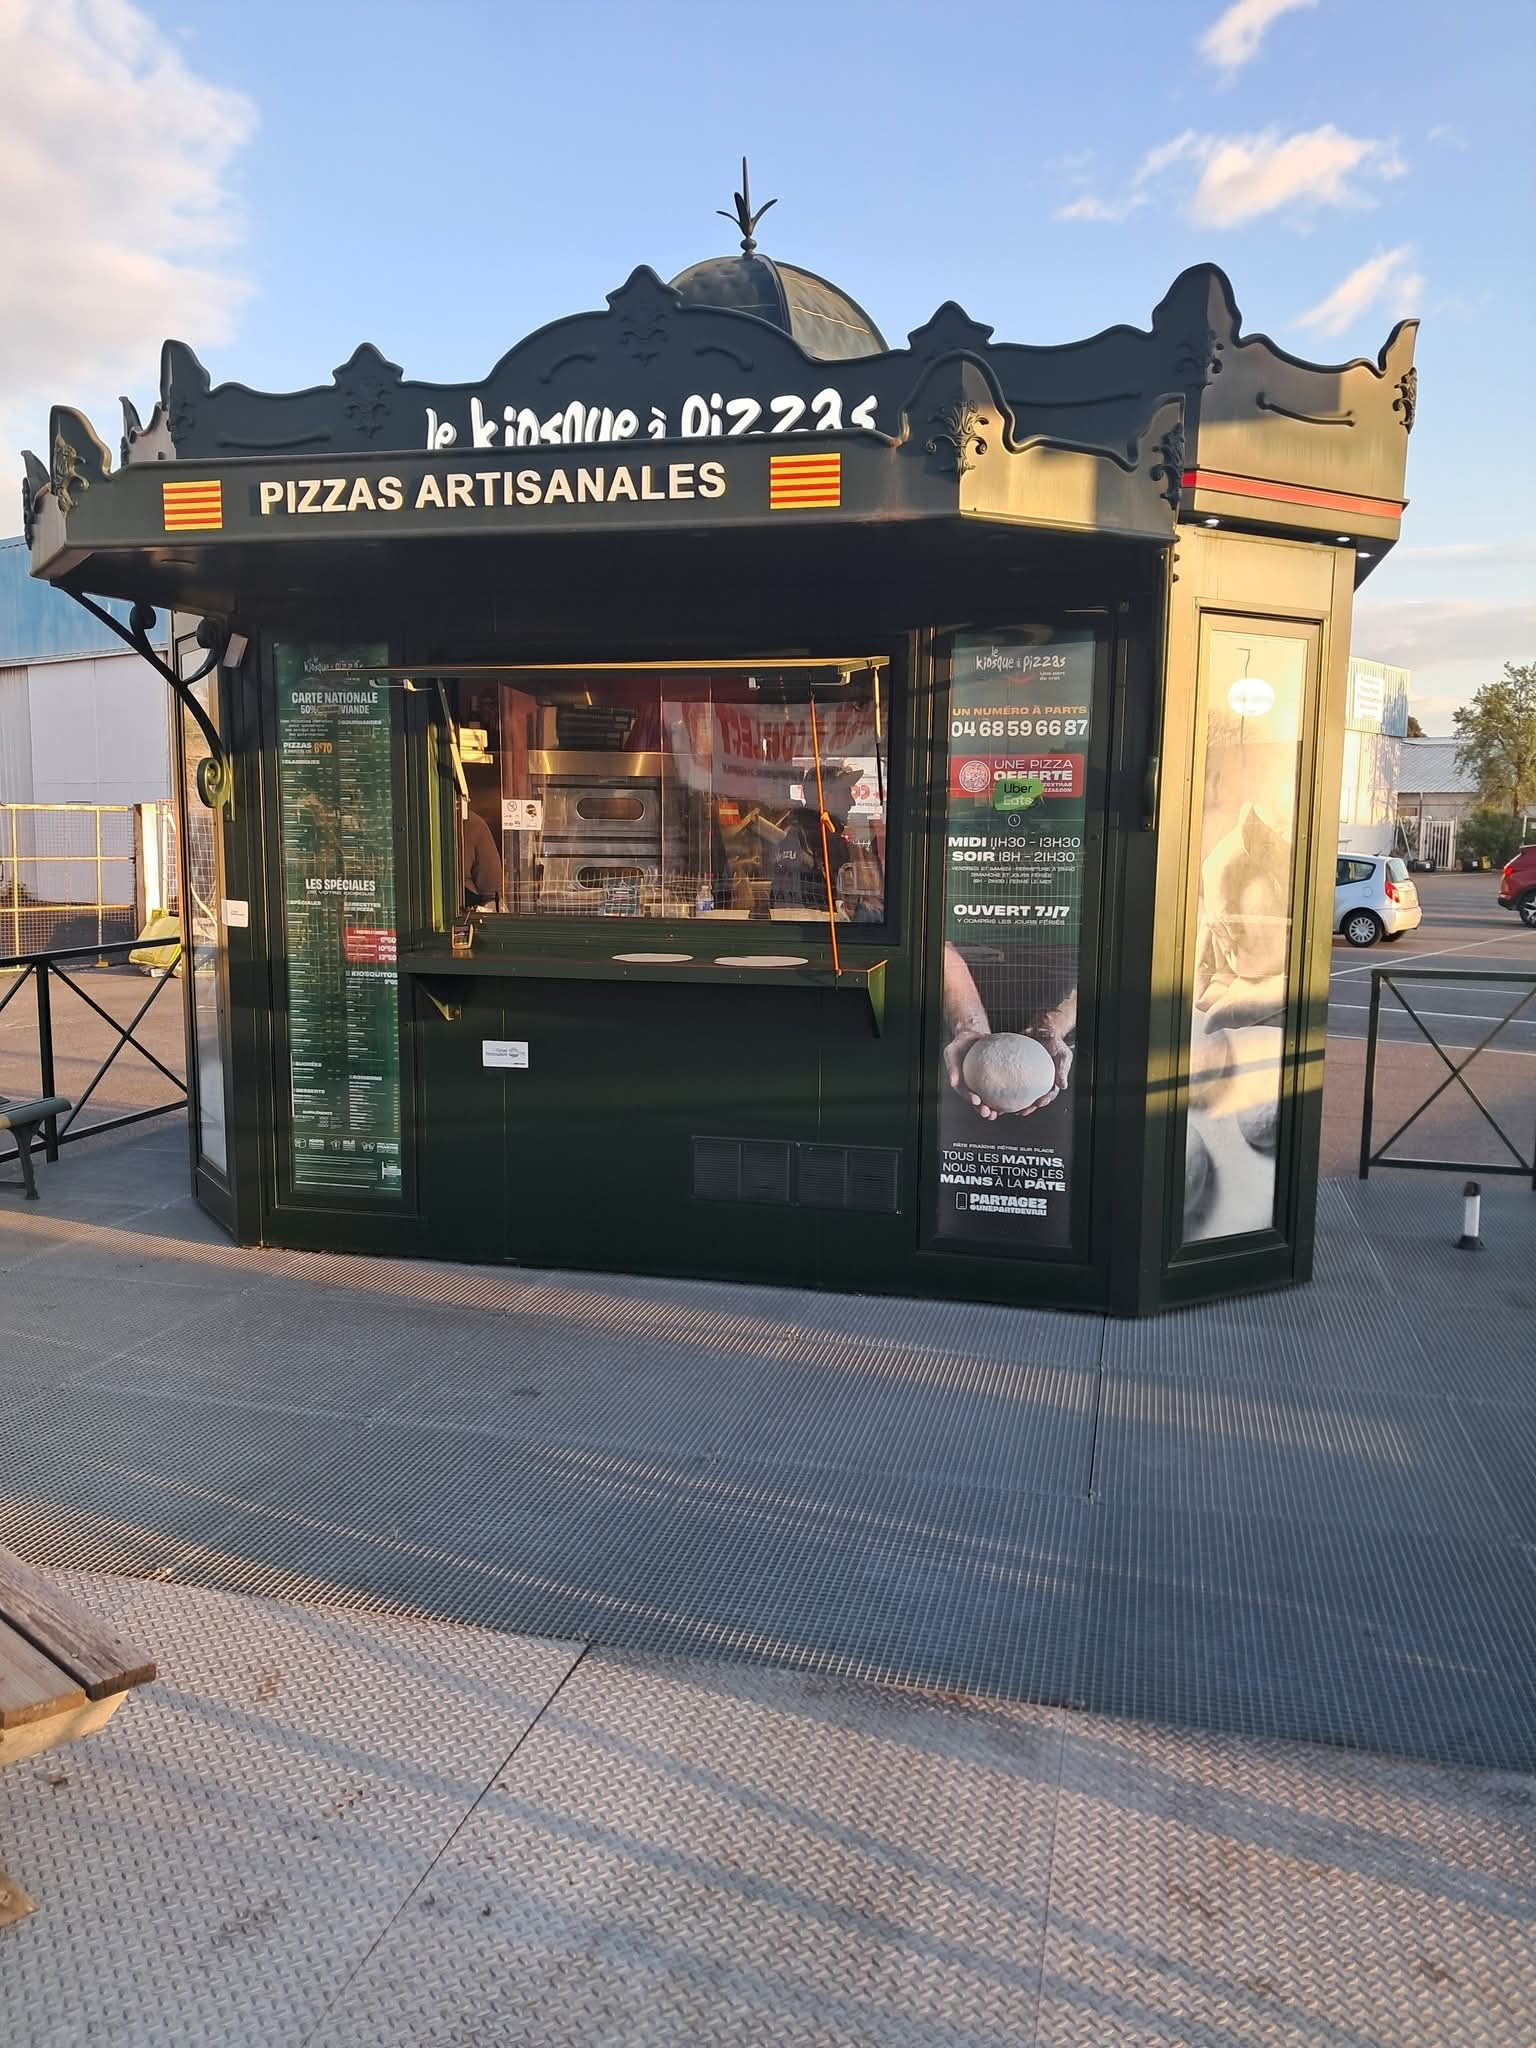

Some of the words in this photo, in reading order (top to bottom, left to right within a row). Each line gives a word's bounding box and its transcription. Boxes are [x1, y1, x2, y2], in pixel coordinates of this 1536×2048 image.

[426, 408, 457, 449] le
[259, 476, 403, 514] PIZZAS
[414, 461, 727, 509] ARTISANALES
[976, 655, 1014, 672] kiosque
[1023, 655, 1066, 672] pizzas
[291, 692, 322, 704] CARTE
[324, 692, 379, 704] NATIONALE
[341, 705, 370, 714] VIANDE
[952, 708, 970, 716] UN
[973, 705, 1029, 716] NUMÉRO
[1032, 704, 1041, 714] À
[1044, 706, 1088, 714] PARTS
[951, 721, 976, 737] 04
[979, 721, 1004, 737] 68
[1007, 721, 1033, 737] 59
[1035, 720, 1061, 736] 66
[1064, 720, 1089, 736] 87
[994, 760, 1025, 769] UNE
[1030, 760, 1073, 769] PIZZA
[993, 770, 1073, 780] OFFERTE
[1004, 783, 1033, 794] Uber
[1003, 795, 1034, 807] Eats
[948, 837, 987, 848] MIDI
[1040, 837, 1080, 848] 13H30
[952, 851, 995, 862] SOIR
[999, 852, 1020, 862] 18H
[1034, 852, 1075, 863] 21H30
[305, 879, 323, 890] LES
[324, 876, 376, 892] SPÉCIALES
[954, 905, 1031, 917] OUVERT
[1034, 906, 1070, 919] 7J/7
[942, 1150, 974, 1161] TOUS
[977, 1153, 999, 1163] LES
[1002, 1154, 1064, 1168] MATINS,
[942, 1162, 976, 1173] NOUS
[980, 1164, 1038, 1177] METTONS
[1041, 1169, 1064, 1180] LES
[940, 1173, 993, 1186] MAINS
[995, 1175, 1004, 1187] À
[1007, 1179, 1022, 1188] LA
[1024, 1178, 1066, 1192] PÂTE
[969, 1193, 1047, 1209] PARTAGEZ
